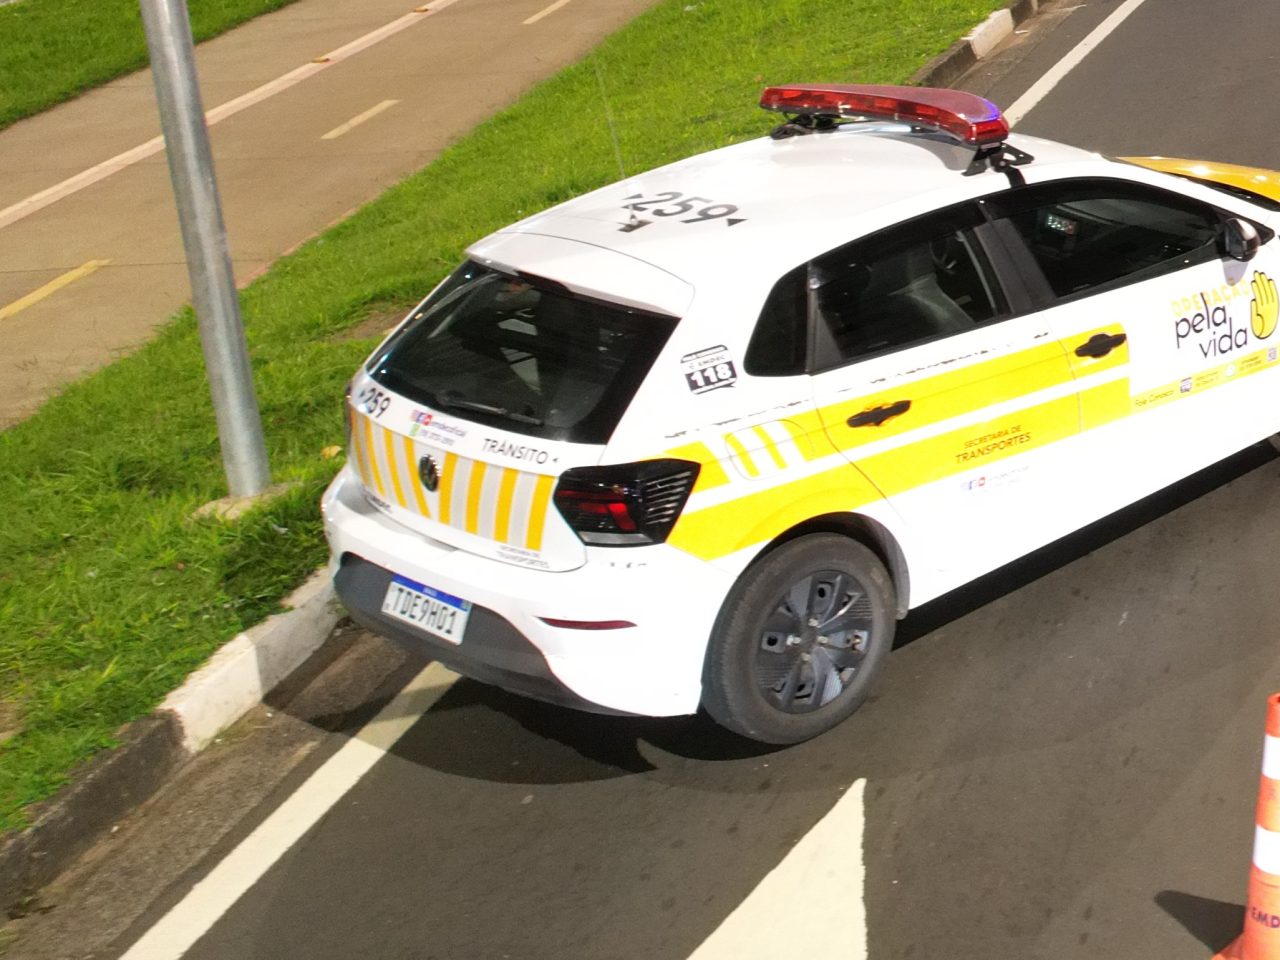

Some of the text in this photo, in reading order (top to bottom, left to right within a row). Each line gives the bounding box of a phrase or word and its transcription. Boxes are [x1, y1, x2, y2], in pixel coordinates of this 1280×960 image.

[621, 192, 739, 224] 259
[1175, 292, 1227, 349] pela
[1199, 317, 1249, 358] vida
[690, 363, 732, 387] 118
[364, 387, 391, 418] 259
[1011, 424, 1021, 434] DE
[955, 431, 1031, 464] TRANSPORTES
[392, 587, 457, 634] TDE9H01
